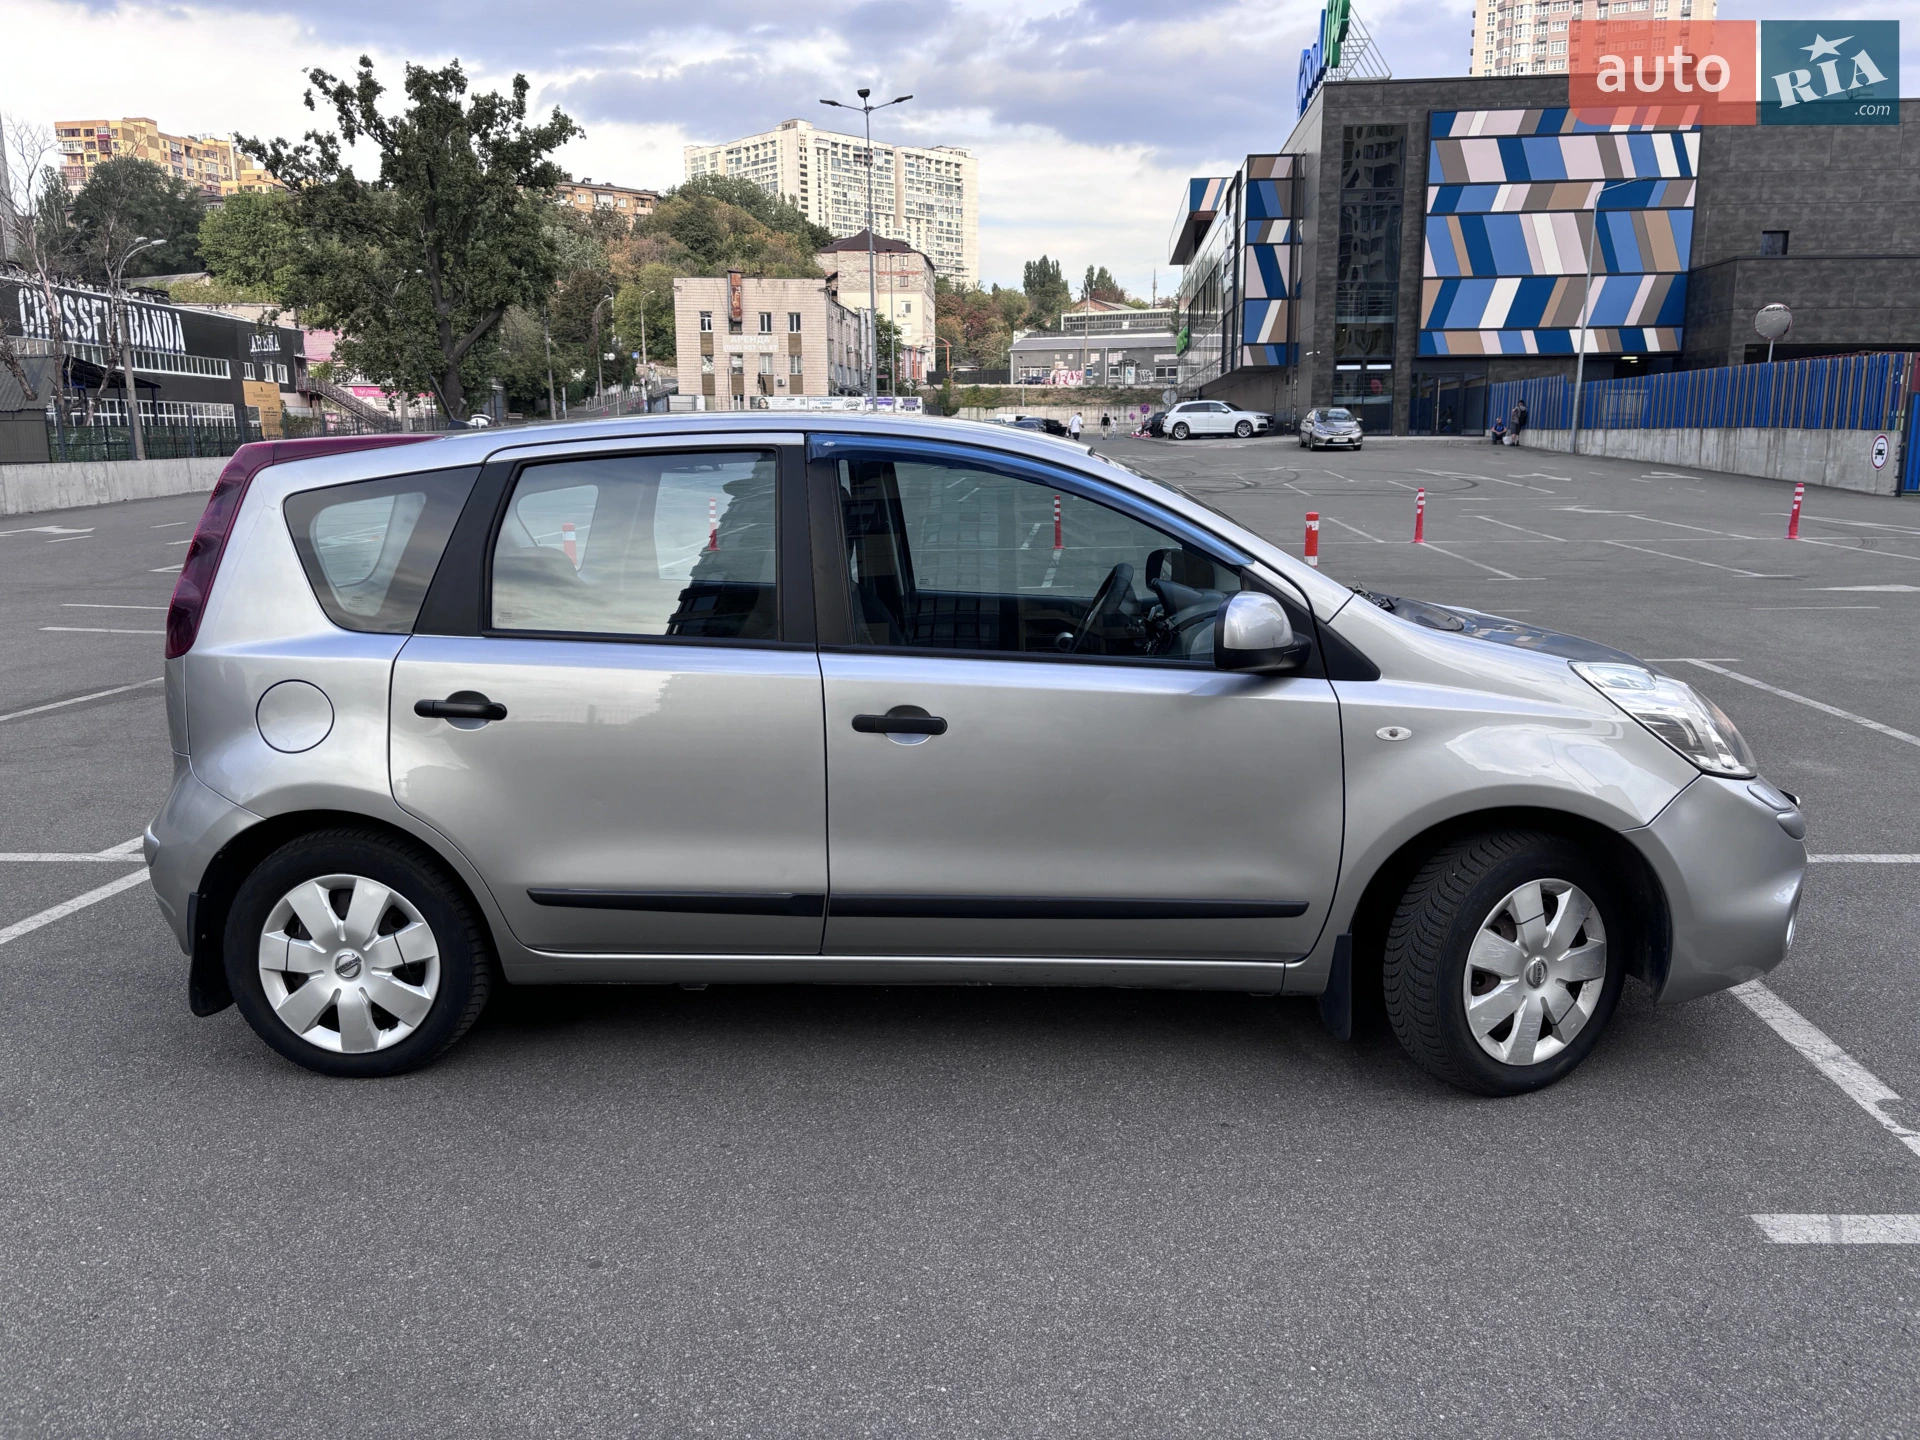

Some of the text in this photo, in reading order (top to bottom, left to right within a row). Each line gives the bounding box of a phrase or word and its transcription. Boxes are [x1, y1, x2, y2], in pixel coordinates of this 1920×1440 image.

[127, 305, 187, 352] BANDA
[250, 334, 281, 352] ARENA
[731, 336, 770, 344] АРЕНДА
